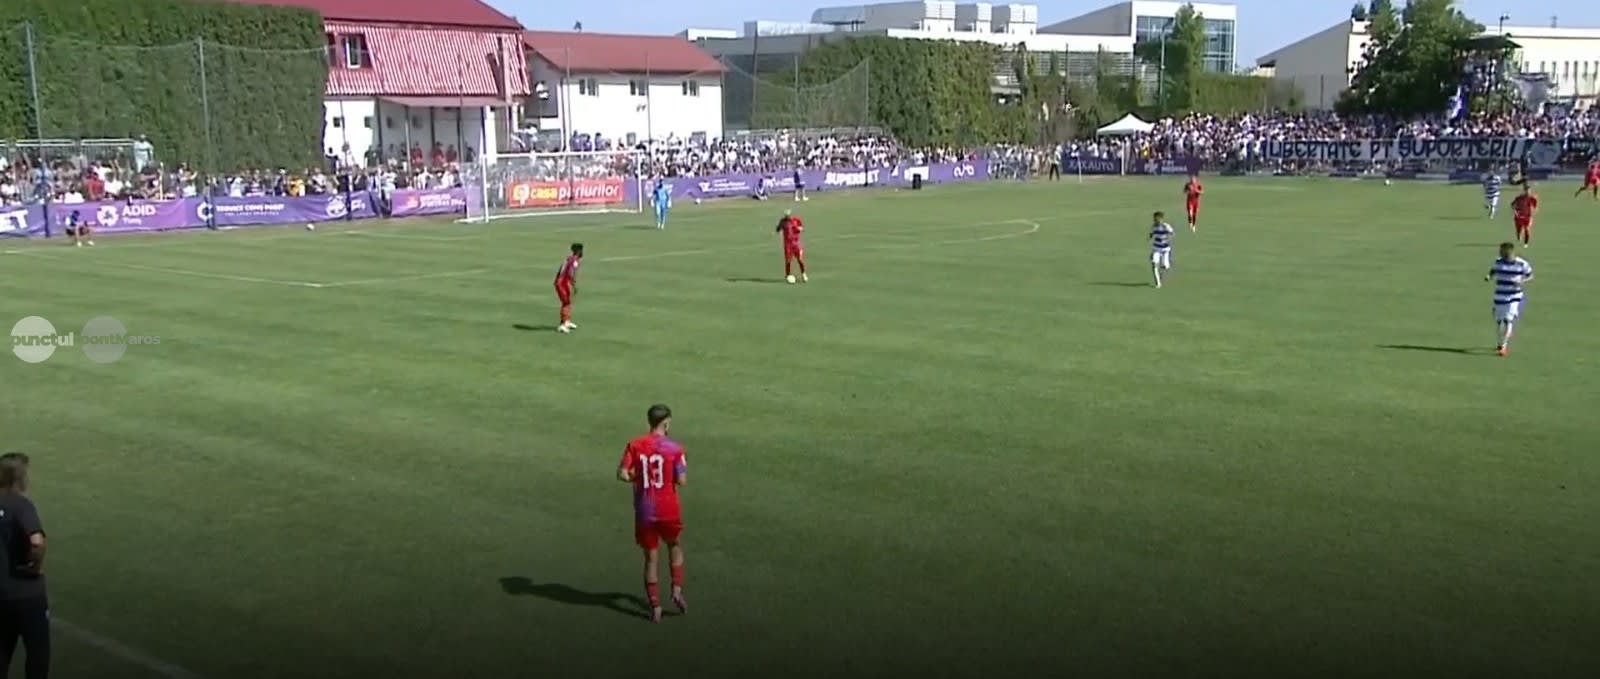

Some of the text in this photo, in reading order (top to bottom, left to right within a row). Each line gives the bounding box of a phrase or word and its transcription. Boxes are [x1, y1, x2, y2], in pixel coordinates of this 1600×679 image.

[824, 169, 880, 187] SUPERBET
[122, 204, 157, 217] ADID
[640, 453, 664, 489] 13
